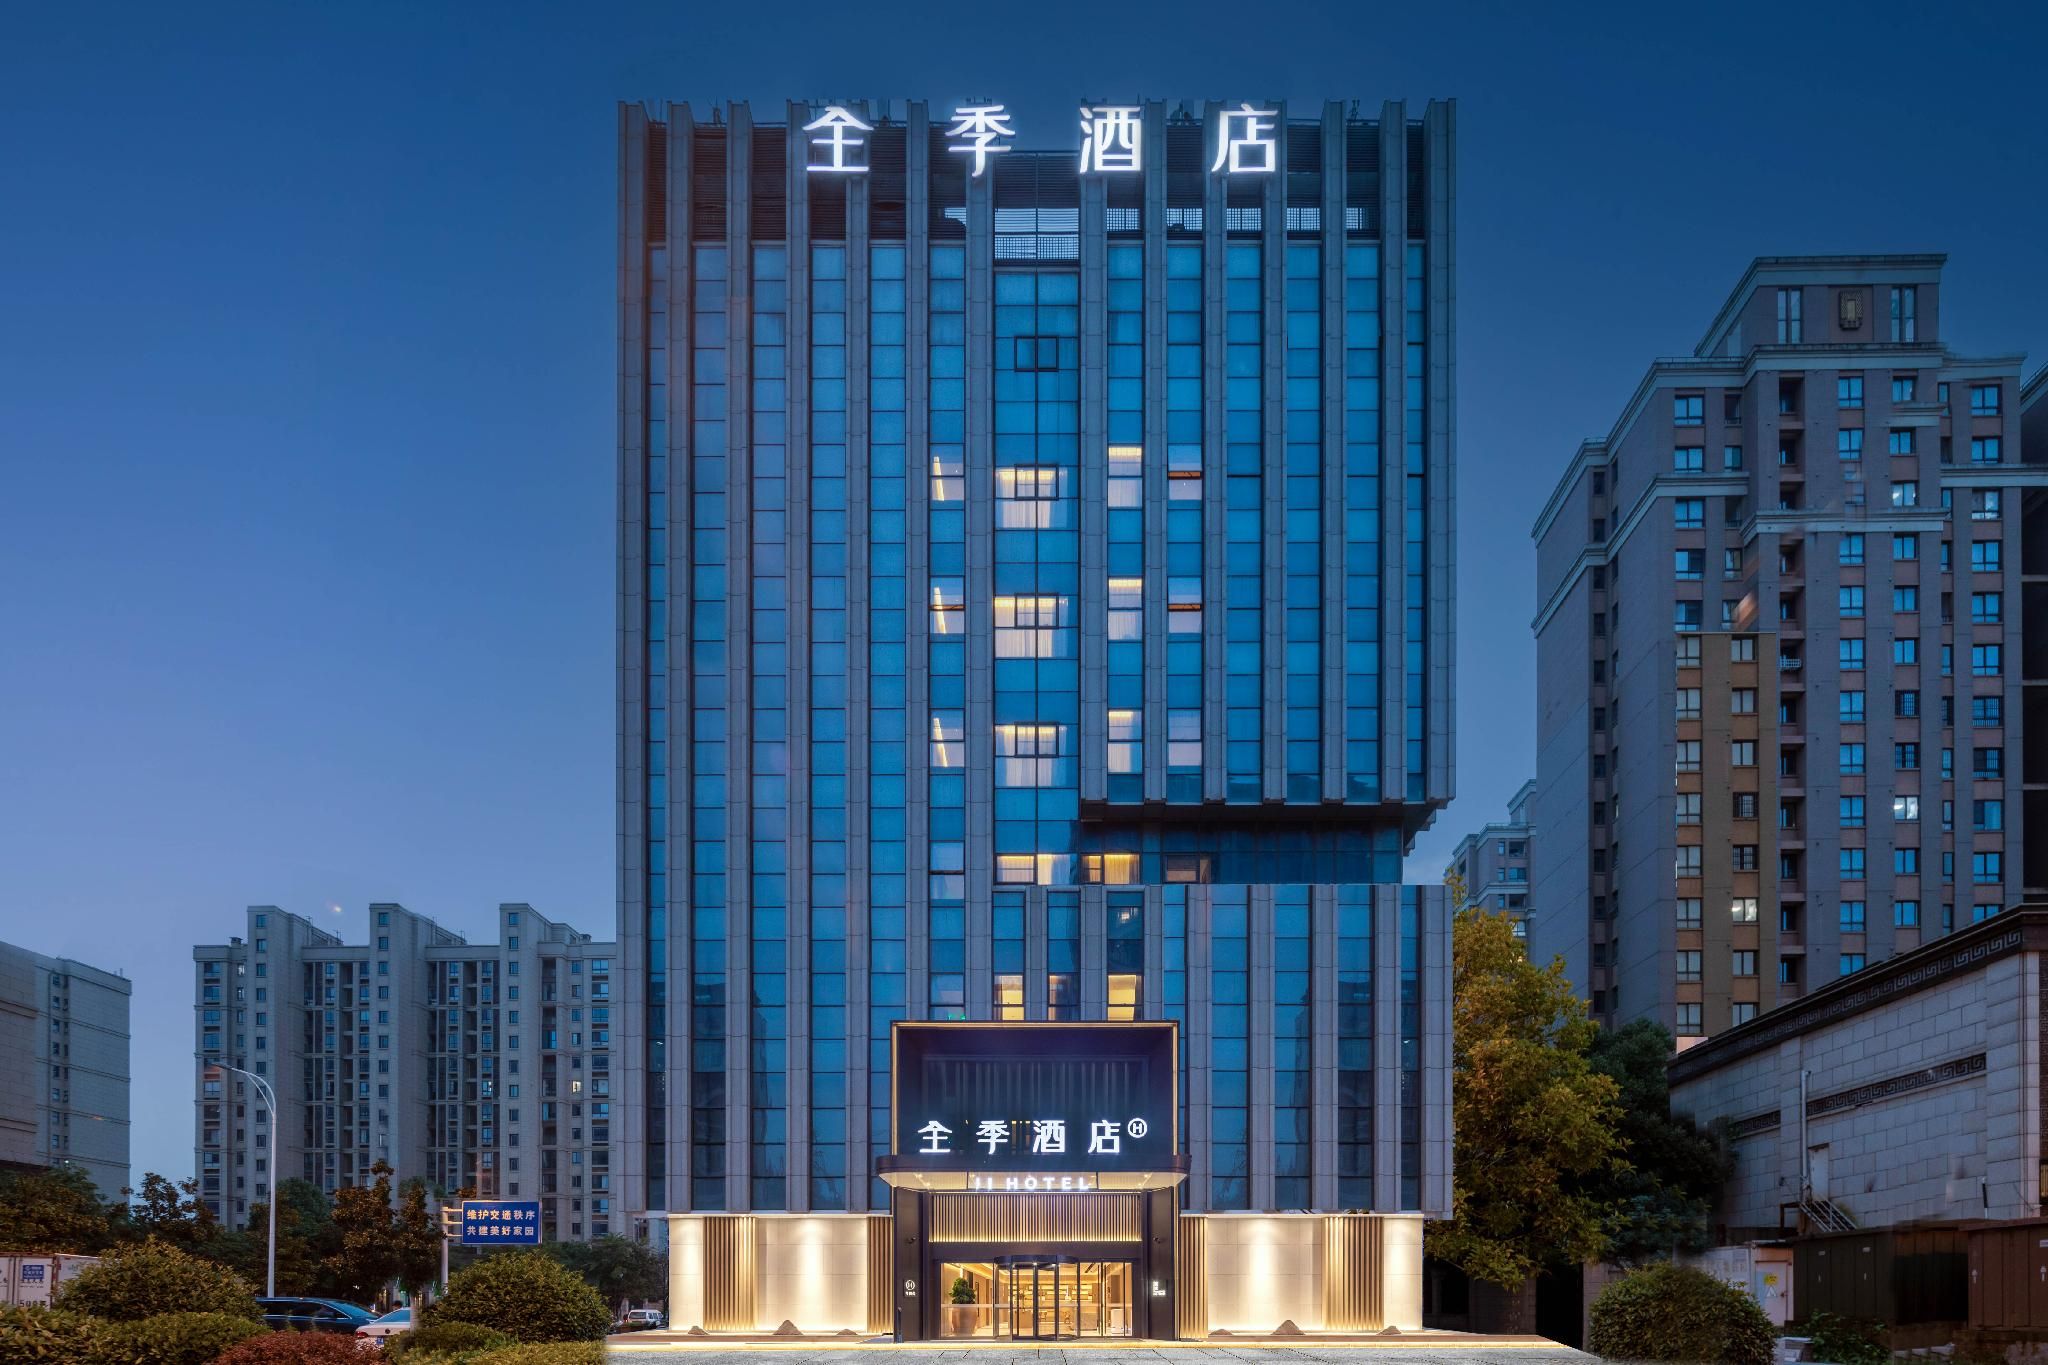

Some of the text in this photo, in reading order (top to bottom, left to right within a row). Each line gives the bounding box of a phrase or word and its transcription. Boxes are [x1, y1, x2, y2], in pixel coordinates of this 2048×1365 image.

[803, 103, 1279, 178] 全季酒店
[917, 1120, 1121, 1155] 全季酒店
[1007, 1177, 1089, 1190] HOTEL
[467, 1210, 535, 1220] 维护交通秩序
[467, 1226, 534, 1236] 共建美好家园
